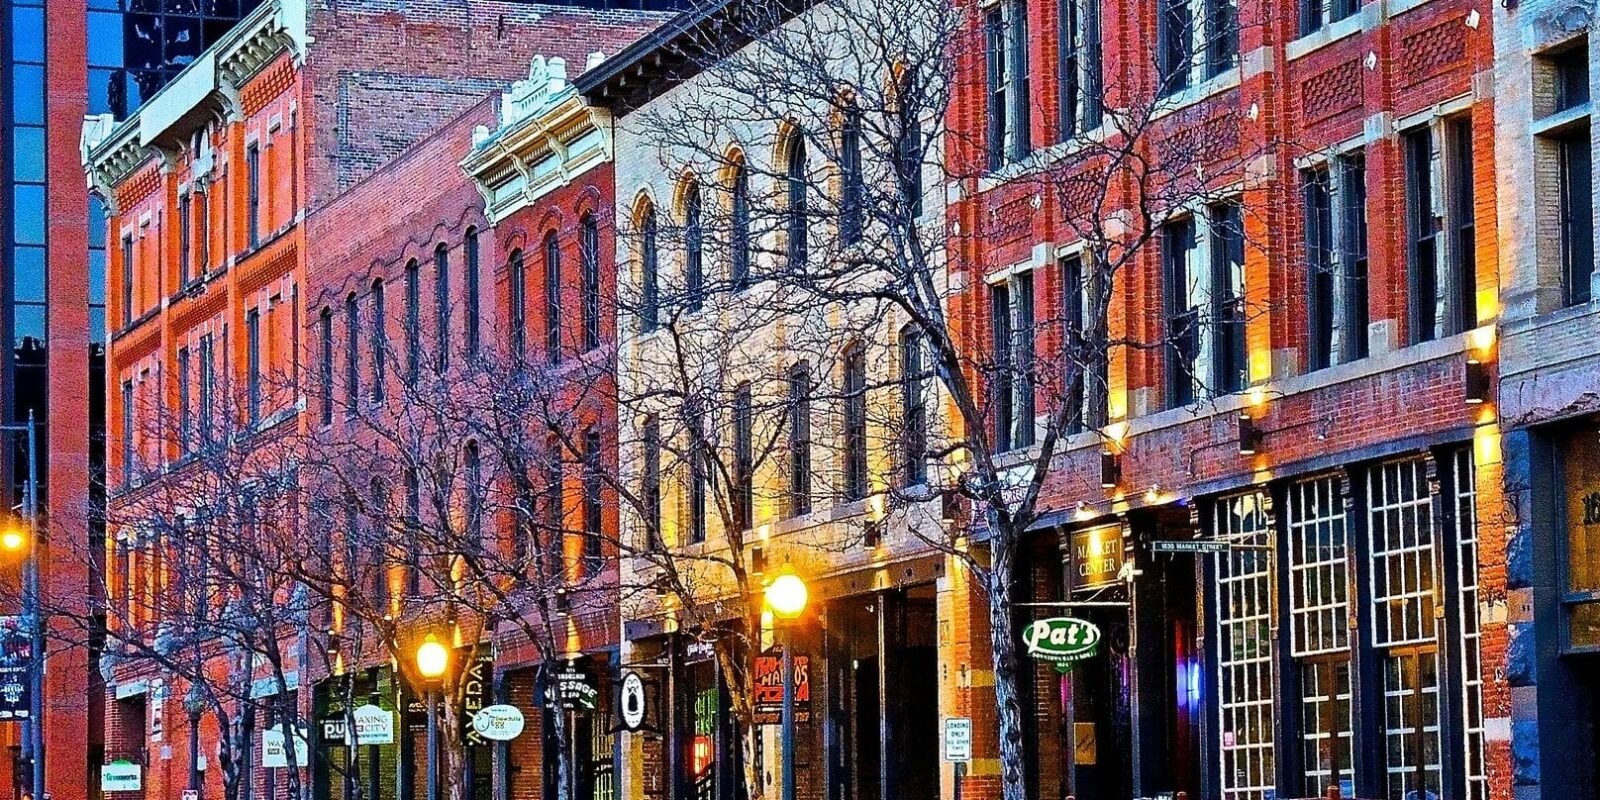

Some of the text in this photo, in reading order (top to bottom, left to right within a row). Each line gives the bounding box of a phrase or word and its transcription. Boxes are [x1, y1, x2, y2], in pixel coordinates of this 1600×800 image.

[1078, 540, 1117, 559] MARKET
[1079, 558, 1115, 577] CENTER
[1028, 620, 1096, 653] Pat's
[754, 682, 809, 702] PIZA
[355, 715, 388, 724] AXING
[324, 723, 345, 739] pu
